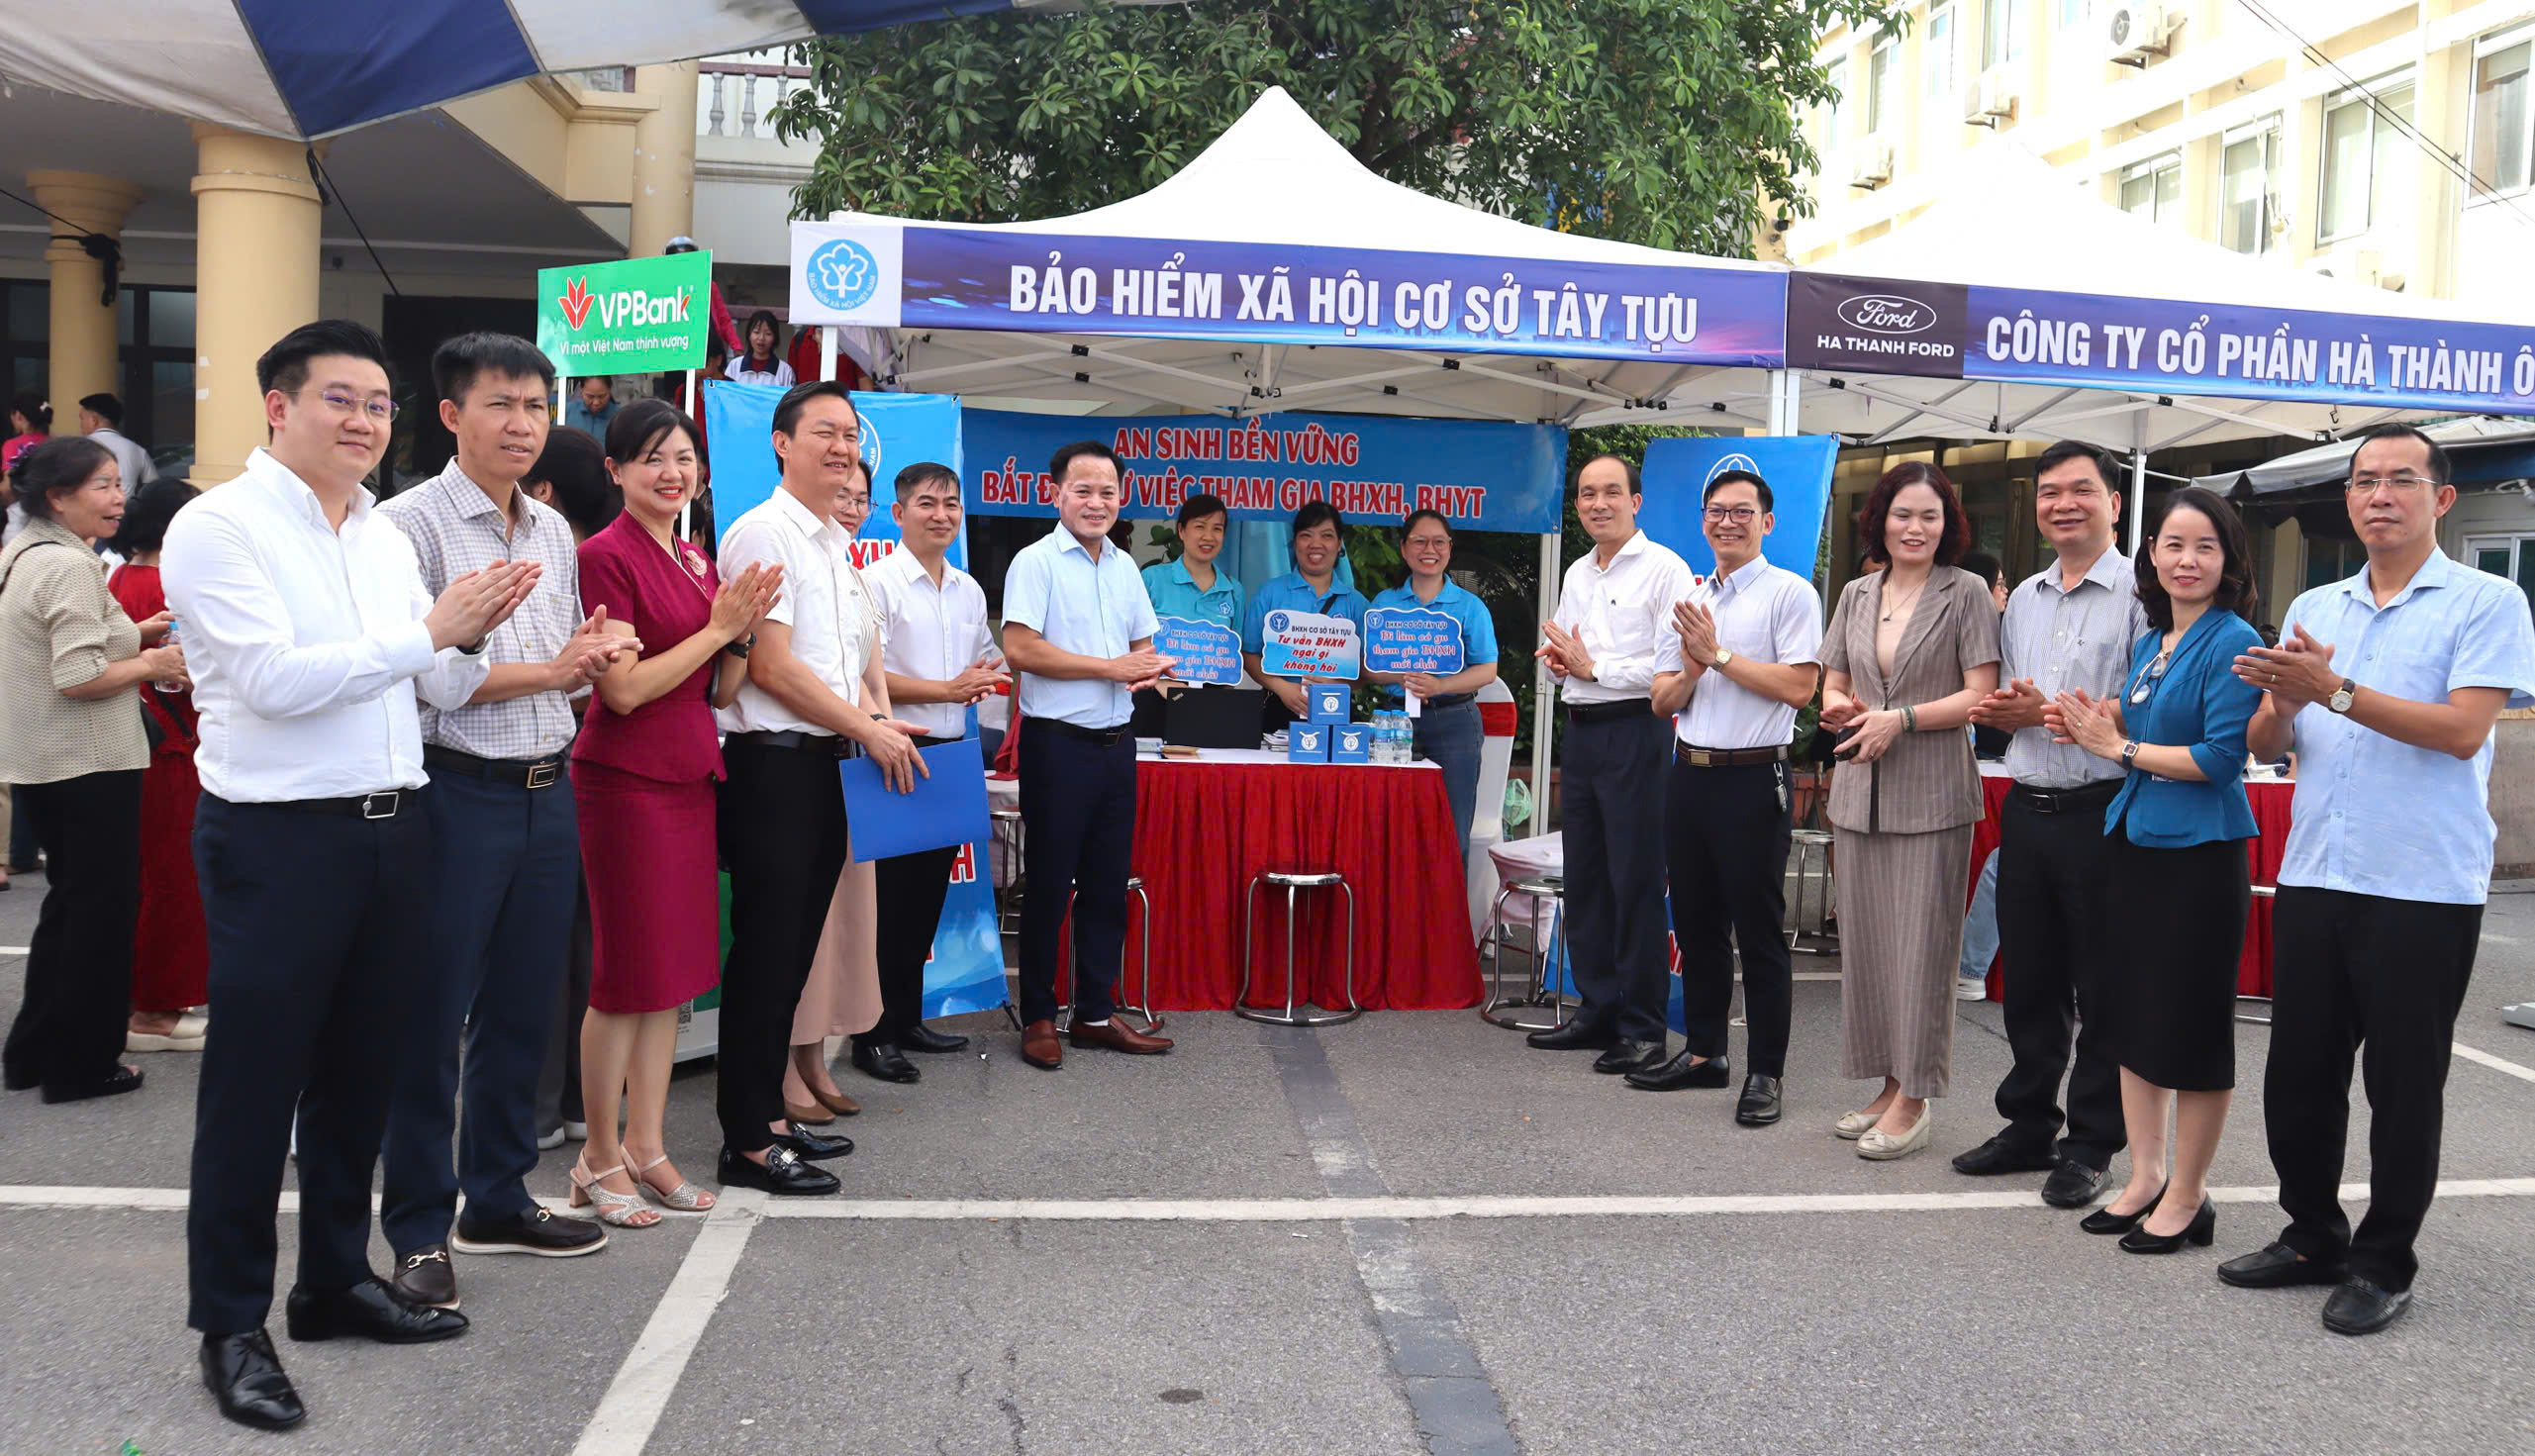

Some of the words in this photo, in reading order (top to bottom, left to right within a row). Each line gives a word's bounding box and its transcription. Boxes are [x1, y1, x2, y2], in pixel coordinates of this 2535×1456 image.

[599, 286, 690, 329] VPBank
[1010, 250, 1097, 315] BẢO
[1112, 251, 1222, 320] HIỂM
[1236, 265, 1295, 323] XÃ
[1309, 269, 1379, 337] HỘI
[1394, 279, 1452, 331] CƠ
[1464, 272, 1521, 335] SỞ
[1533, 282, 1609, 340] TÂY
[1621, 292, 1698, 352] TỰU
[1856, 298, 1915, 329] Ford
[572, 340, 589, 356] một
[592, 339, 610, 355] Việt
[614, 338, 634, 352] Nam
[636, 337, 658, 354] thịnh
[661, 336, 688, 351] vượng
[1817, 336, 1841, 350] HA
[1845, 337, 1904, 354] THANH
[1908, 340, 1954, 357] FORD
[1987, 309, 2091, 367] CÔNG
[2103, 325, 2146, 369] TY
[2157, 315, 2209, 374] CỔ
[2217, 323, 2318, 382] PHẦN
[2328, 334, 2376, 386] HÀ
[2388, 340, 2502, 394] THÀNH
[1114, 428, 1150, 459] AN
[1156, 428, 1222, 460] SINH
[1227, 416, 1279, 462] BỀN
[1284, 423, 1359, 465] VỮNG
[983, 456, 1033, 505] BẮT
[1136, 465, 1196, 516] VIỆC
[1199, 476, 1275, 510] THAM
[1280, 477, 1324, 512] GIA
[1330, 481, 1412, 521] BHXH,
[1416, 484, 1487, 519] BHYT
[1328, 627, 1339, 635] TÂY
[1397, 631, 1415, 641] làm
[1417, 631, 1432, 641] có
[1434, 634, 1448, 644] gu
[1278, 634, 1291, 644] Tư
[1316, 636, 1346, 648] BHXH
[1292, 648, 1316, 660] ngại
[1318, 648, 1330, 660] gì
[1373, 643, 1400, 655] tham
[1402, 645, 1418, 657] gia
[1421, 644, 1455, 656] BHXH
[1185, 654, 1202, 666] gia
[1204, 655, 1235, 668] BHXH
[1283, 659, 1316, 673] không
[1319, 662, 1338, 673] hỏi
[1391, 658, 1411, 668] mới
[1414, 656, 1437, 669] chất
